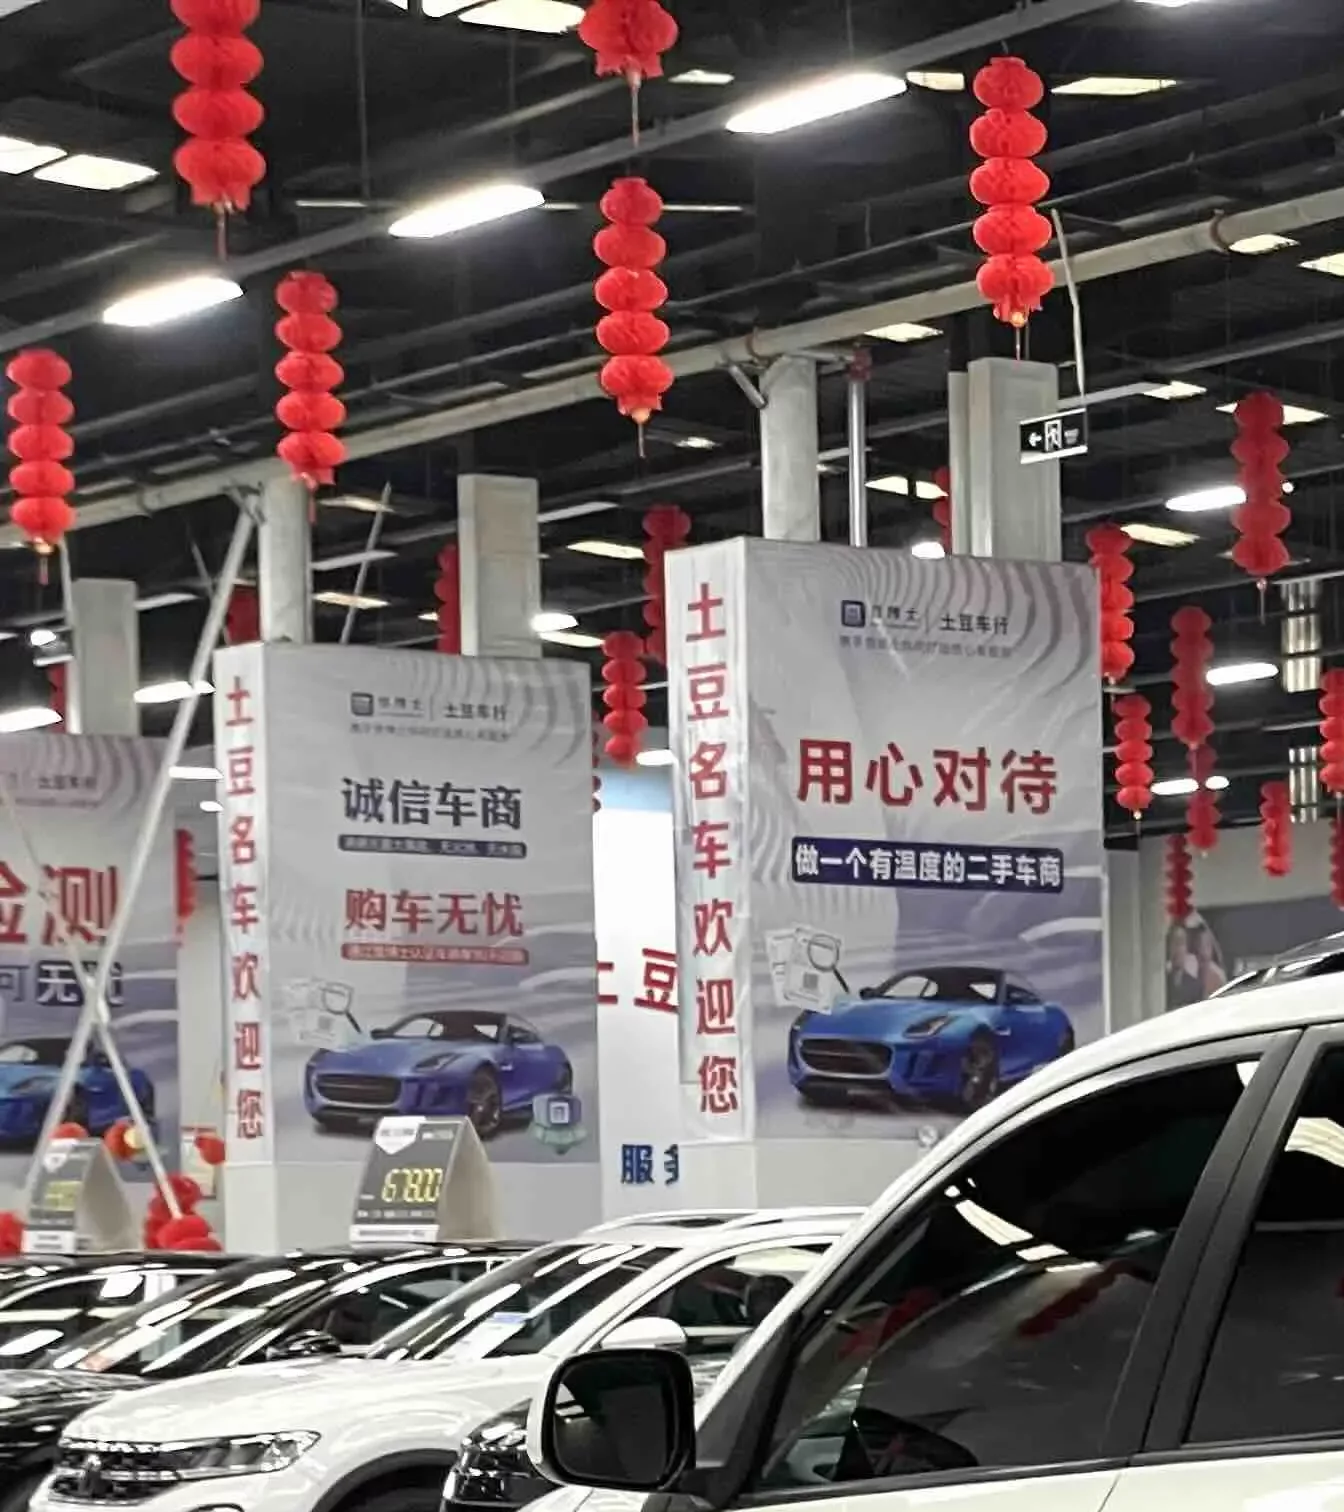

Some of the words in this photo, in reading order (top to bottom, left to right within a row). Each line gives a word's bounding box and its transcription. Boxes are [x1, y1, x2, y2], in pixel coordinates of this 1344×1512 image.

[342, 777, 522, 830] 诚信车商
[797, 738, 1058, 816] 用心对待
[686, 582, 738, 1114] 土豆名车欢迎您
[794, 843, 1062, 887] 做一个有温度的二手车商
[224, 676, 266, 1138] 土豆名车欢迎您
[345, 888, 524, 937] 购车无忧
